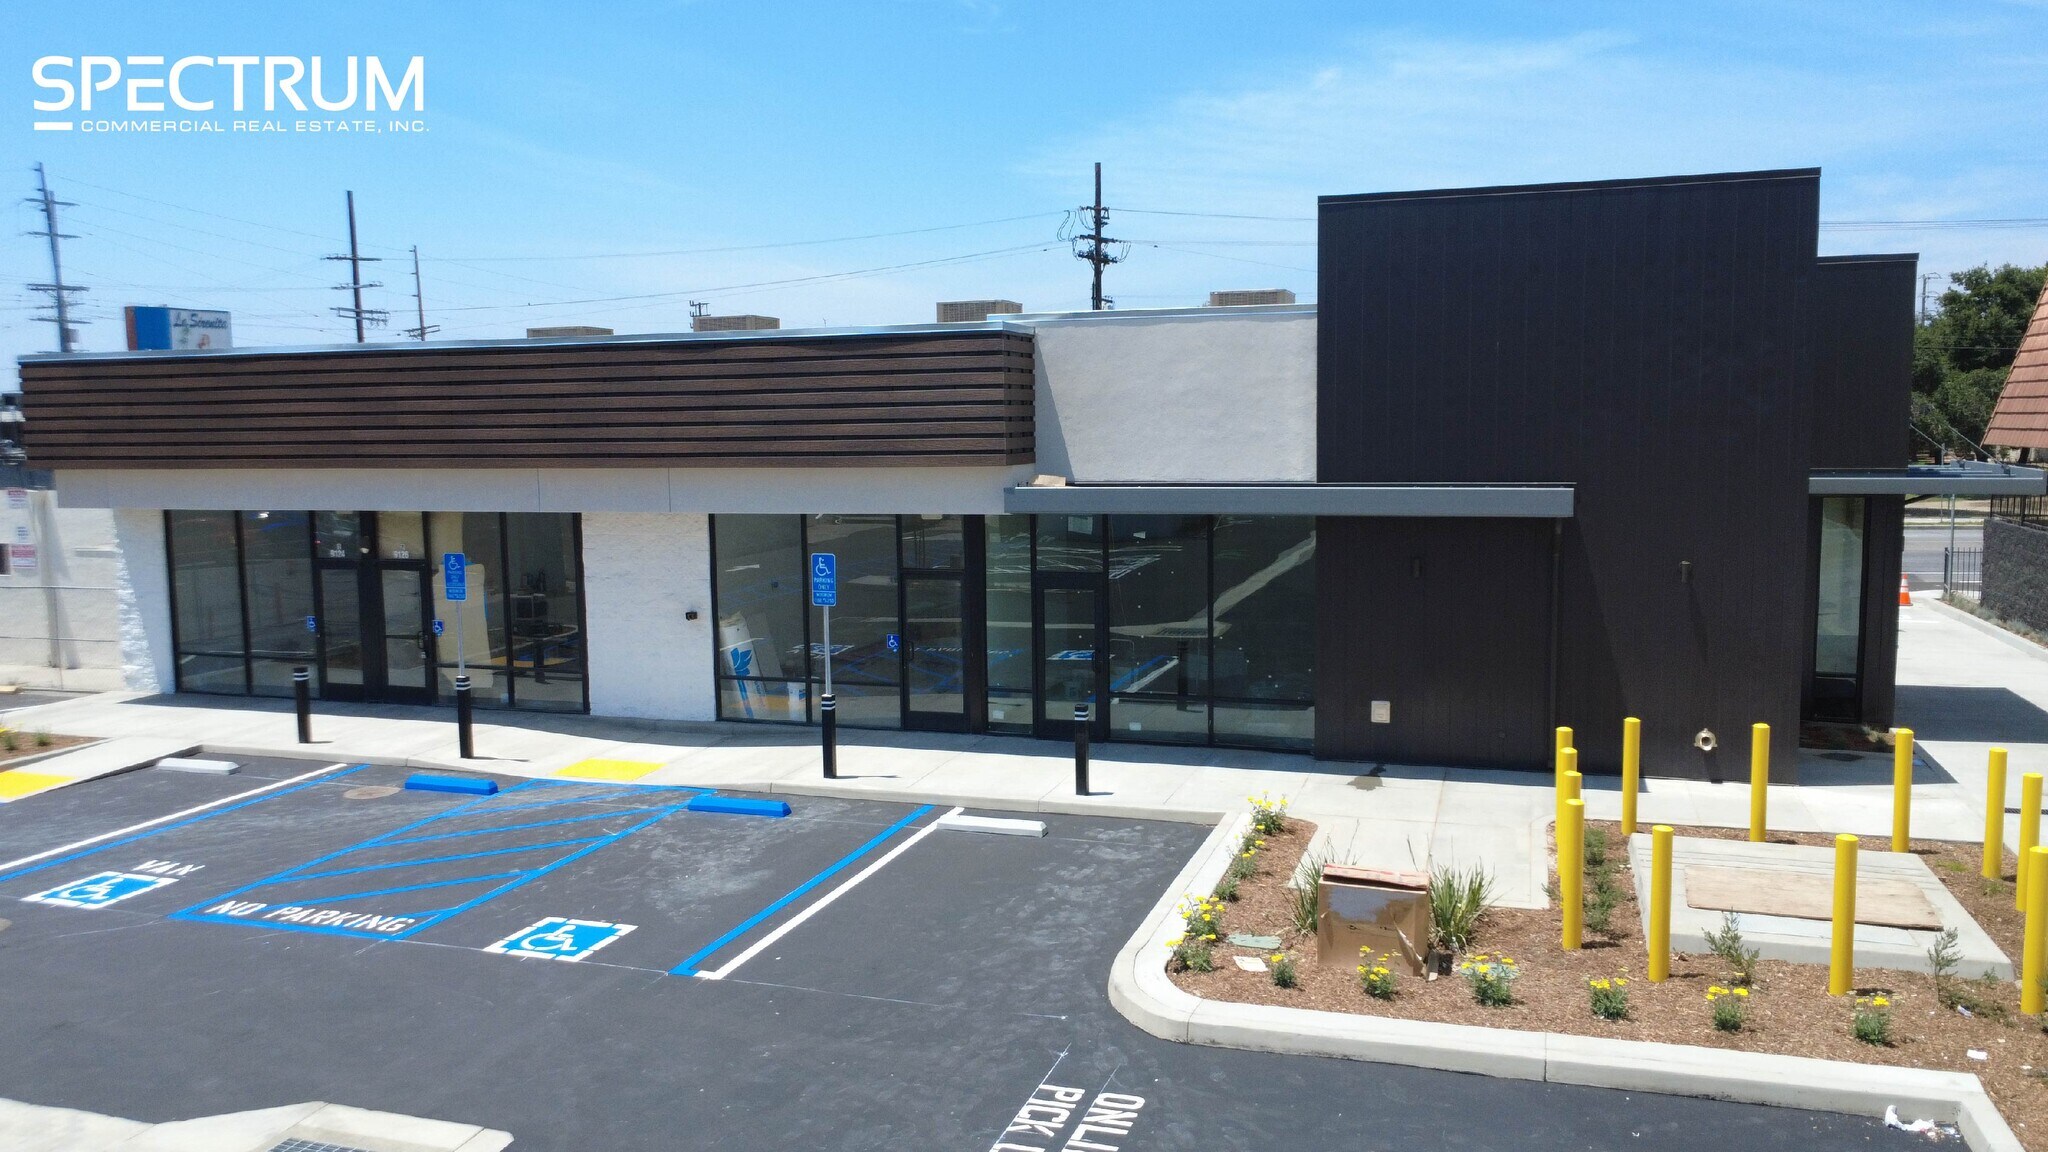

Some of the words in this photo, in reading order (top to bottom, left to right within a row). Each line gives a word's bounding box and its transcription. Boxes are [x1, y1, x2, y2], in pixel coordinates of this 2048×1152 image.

[131, 860, 205, 875] VAN
[205, 901, 267, 916] NO
[262, 906, 415, 931] PARKING
[1006, 1084, 1086, 1138] PICK
[1061, 1092, 1145, 1152] ONLI
